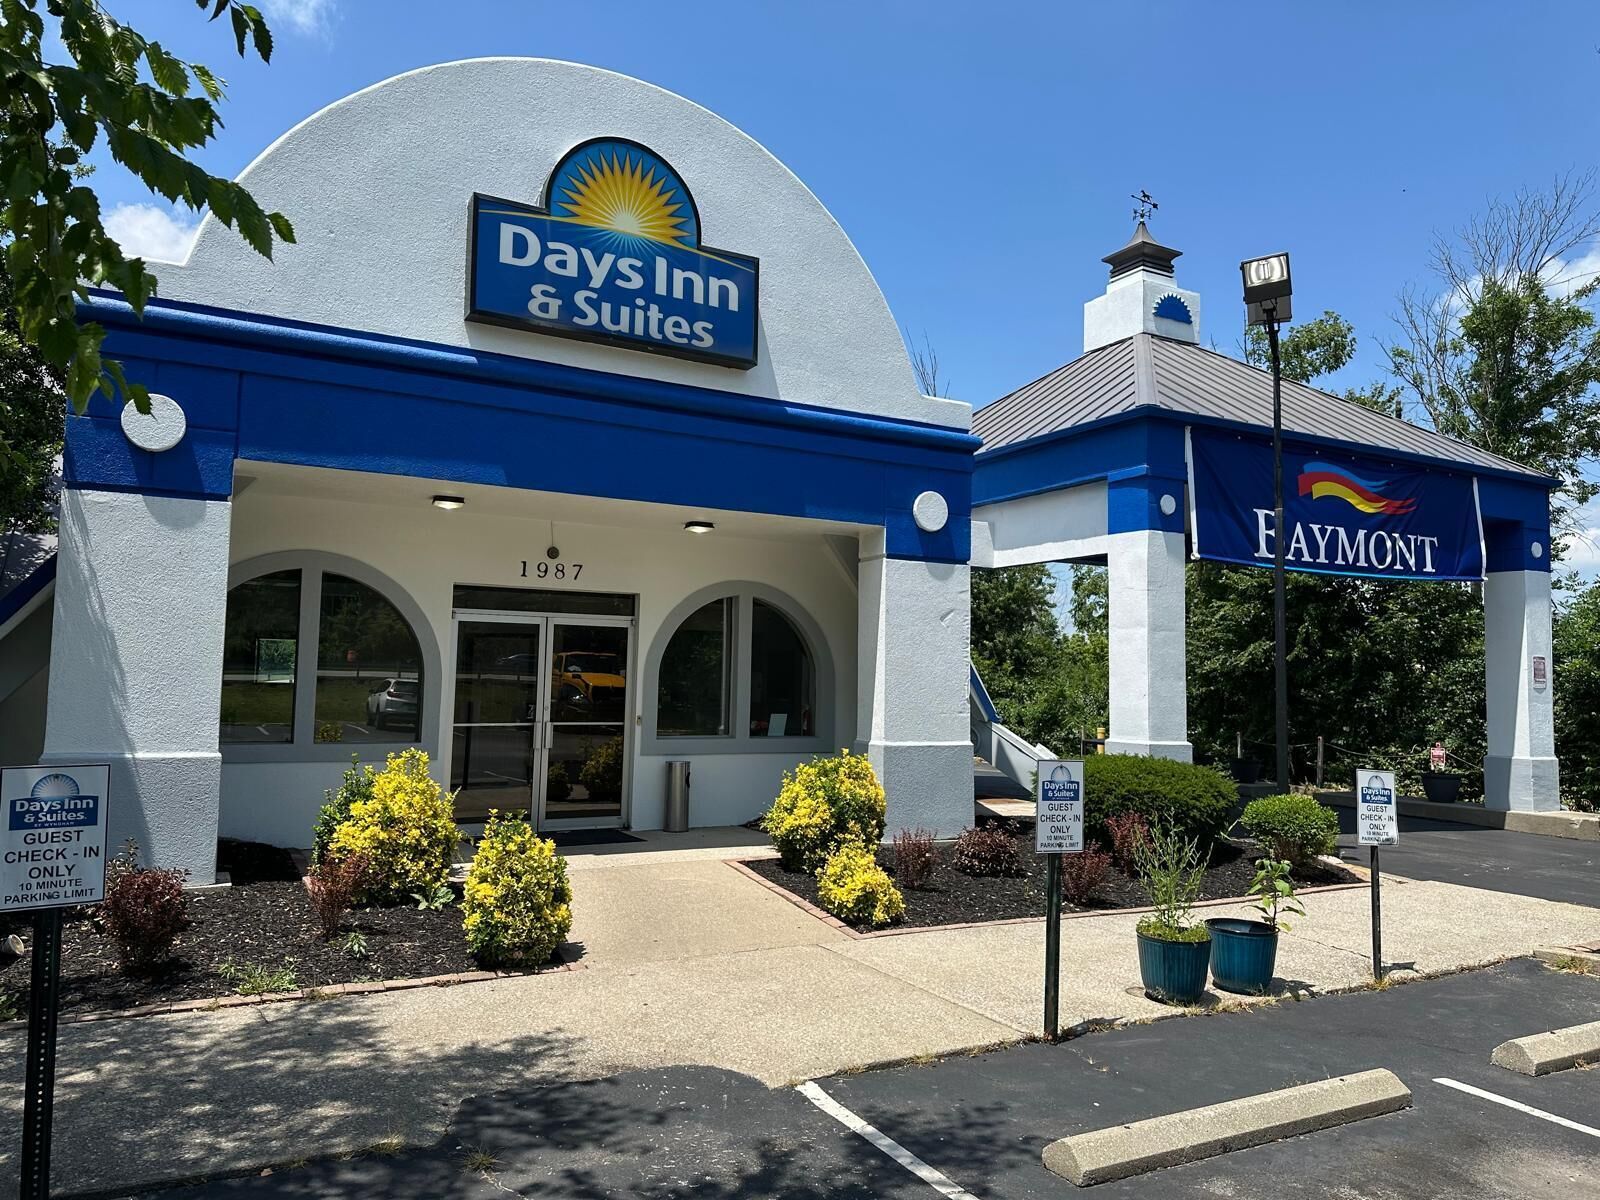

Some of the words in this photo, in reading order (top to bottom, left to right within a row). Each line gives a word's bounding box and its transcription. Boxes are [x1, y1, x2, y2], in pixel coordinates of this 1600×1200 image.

[499, 222, 644, 290] Days
[655, 256, 739, 312] Inn
[527, 284, 562, 320] &
[572, 290, 714, 348] Suites
[1253, 508, 1438, 573] BAYMONT
[520, 560, 583, 581] 1987
[1044, 781, 1063, 790] Days
[1064, 781, 1078, 790] Inn
[16, 800, 62, 812] Days
[64, 798, 94, 809] Inn
[1048, 803, 1074, 812] GUEST
[24, 813, 35, 823] &
[38, 811, 84, 822] Suites
[1040, 814, 1066, 822] CHECK
[1360, 814, 1382, 822] CHECK
[1050, 826, 1070, 834] ONLY
[24, 830, 84, 845] GUEST
[4, 848, 67, 864] CHECK
[28, 864, 76, 879] ONLY
[19, 882, 32, 891] 10
[36, 878, 82, 890] MINUTE
[4, 891, 60, 904] PARKING
[64, 888, 96, 898] LIMIT
